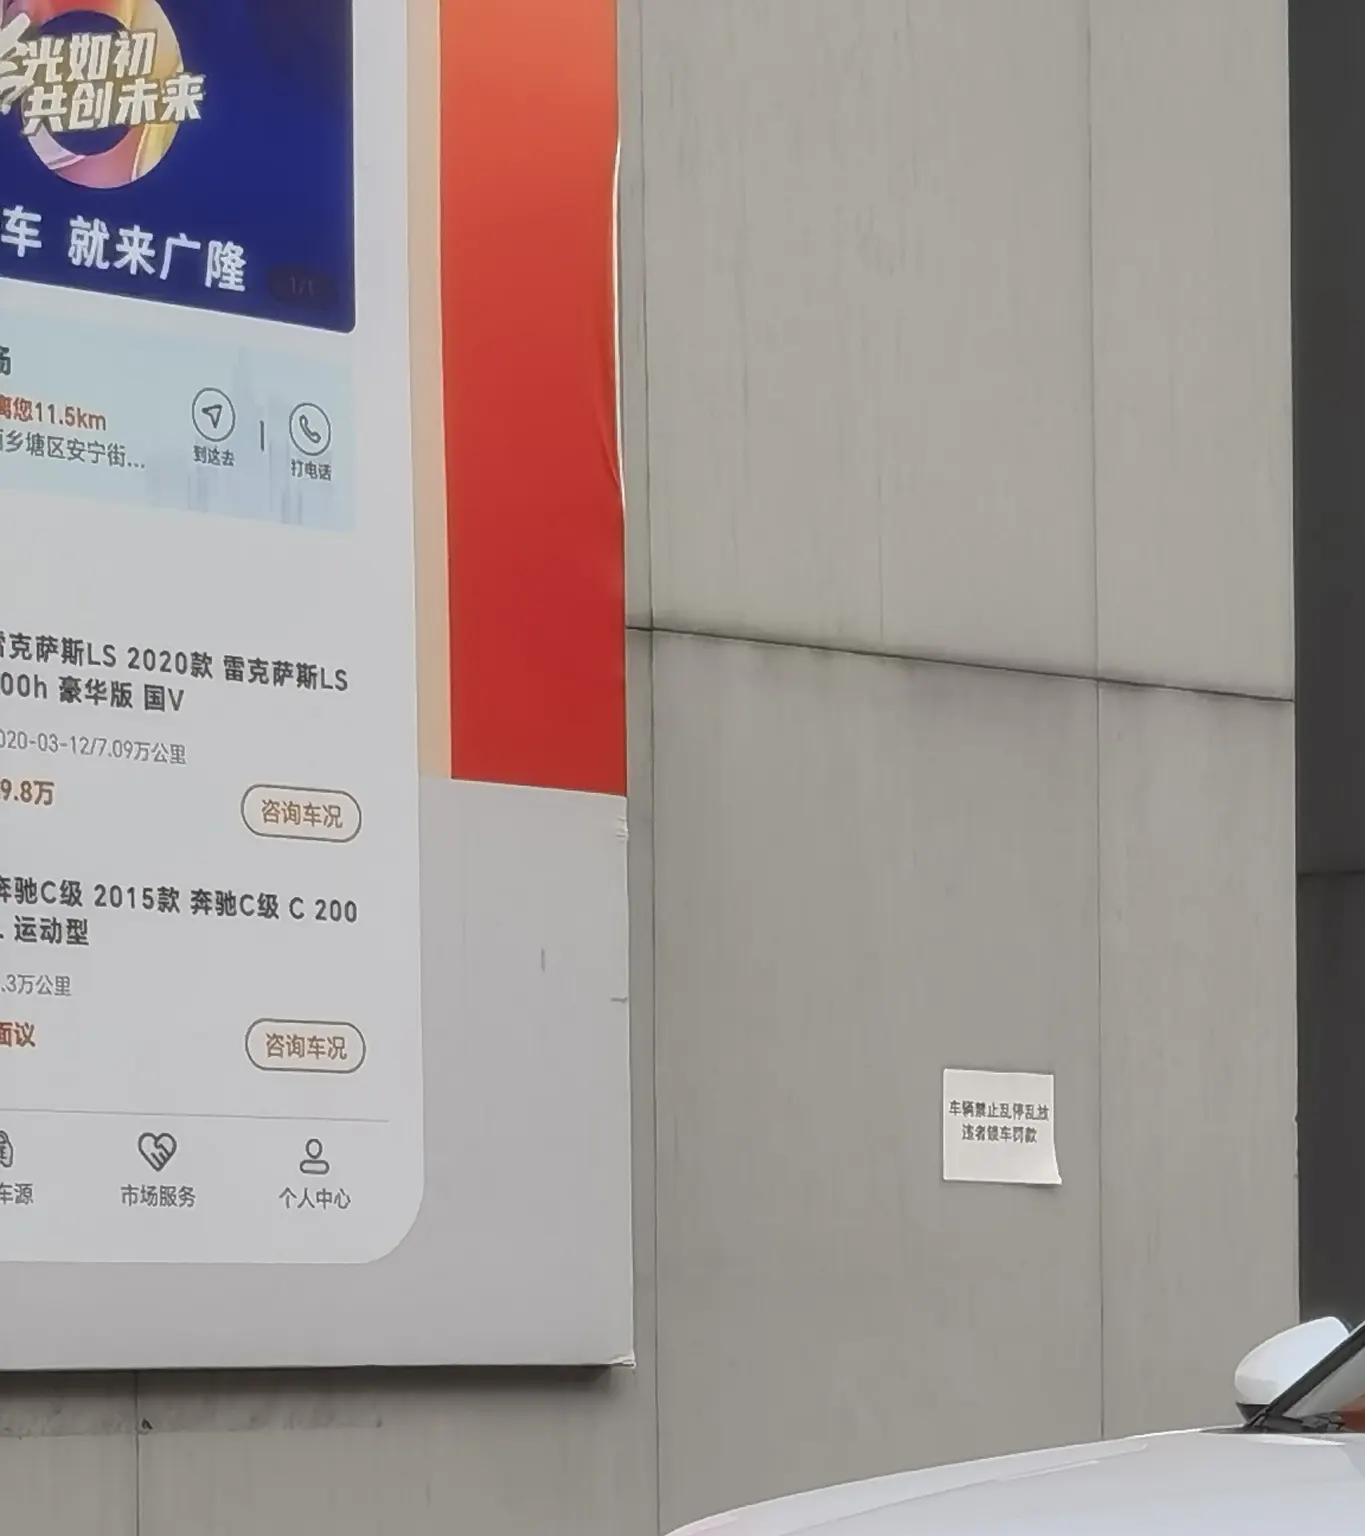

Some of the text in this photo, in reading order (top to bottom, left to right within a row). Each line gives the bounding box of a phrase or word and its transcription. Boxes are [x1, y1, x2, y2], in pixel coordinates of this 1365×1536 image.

[23, 74, 206, 134] 共创未来
[1, 205, 247, 292] 车 就来广隆
[0, 429, 145, 468] 乡塘区安宁街...
[193, 445, 235, 467] 到这去
[291, 460, 332, 481] 打电话
[0, 630, 348, 692] 克萨斯LS 2020款 雷克萨斯LS
[58, 675, 134, 709] 豪华版
[144, 684, 185, 713] 国V
[260, 799, 343, 829] 咨询车况
[94, 884, 181, 914] 2015款
[190, 887, 280, 920] 奔驰C级
[289, 896, 305, 920] C
[314, 898, 358, 923] 200
[13, 914, 90, 946] 运动型
[265, 1033, 348, 1060] 咨询车况
[949, 1100, 1049, 1121] 车辆禁止乱停乱放
[121, 1183, 196, 1208] 市场服务
[278, 1186, 352, 1210] 个人中心
